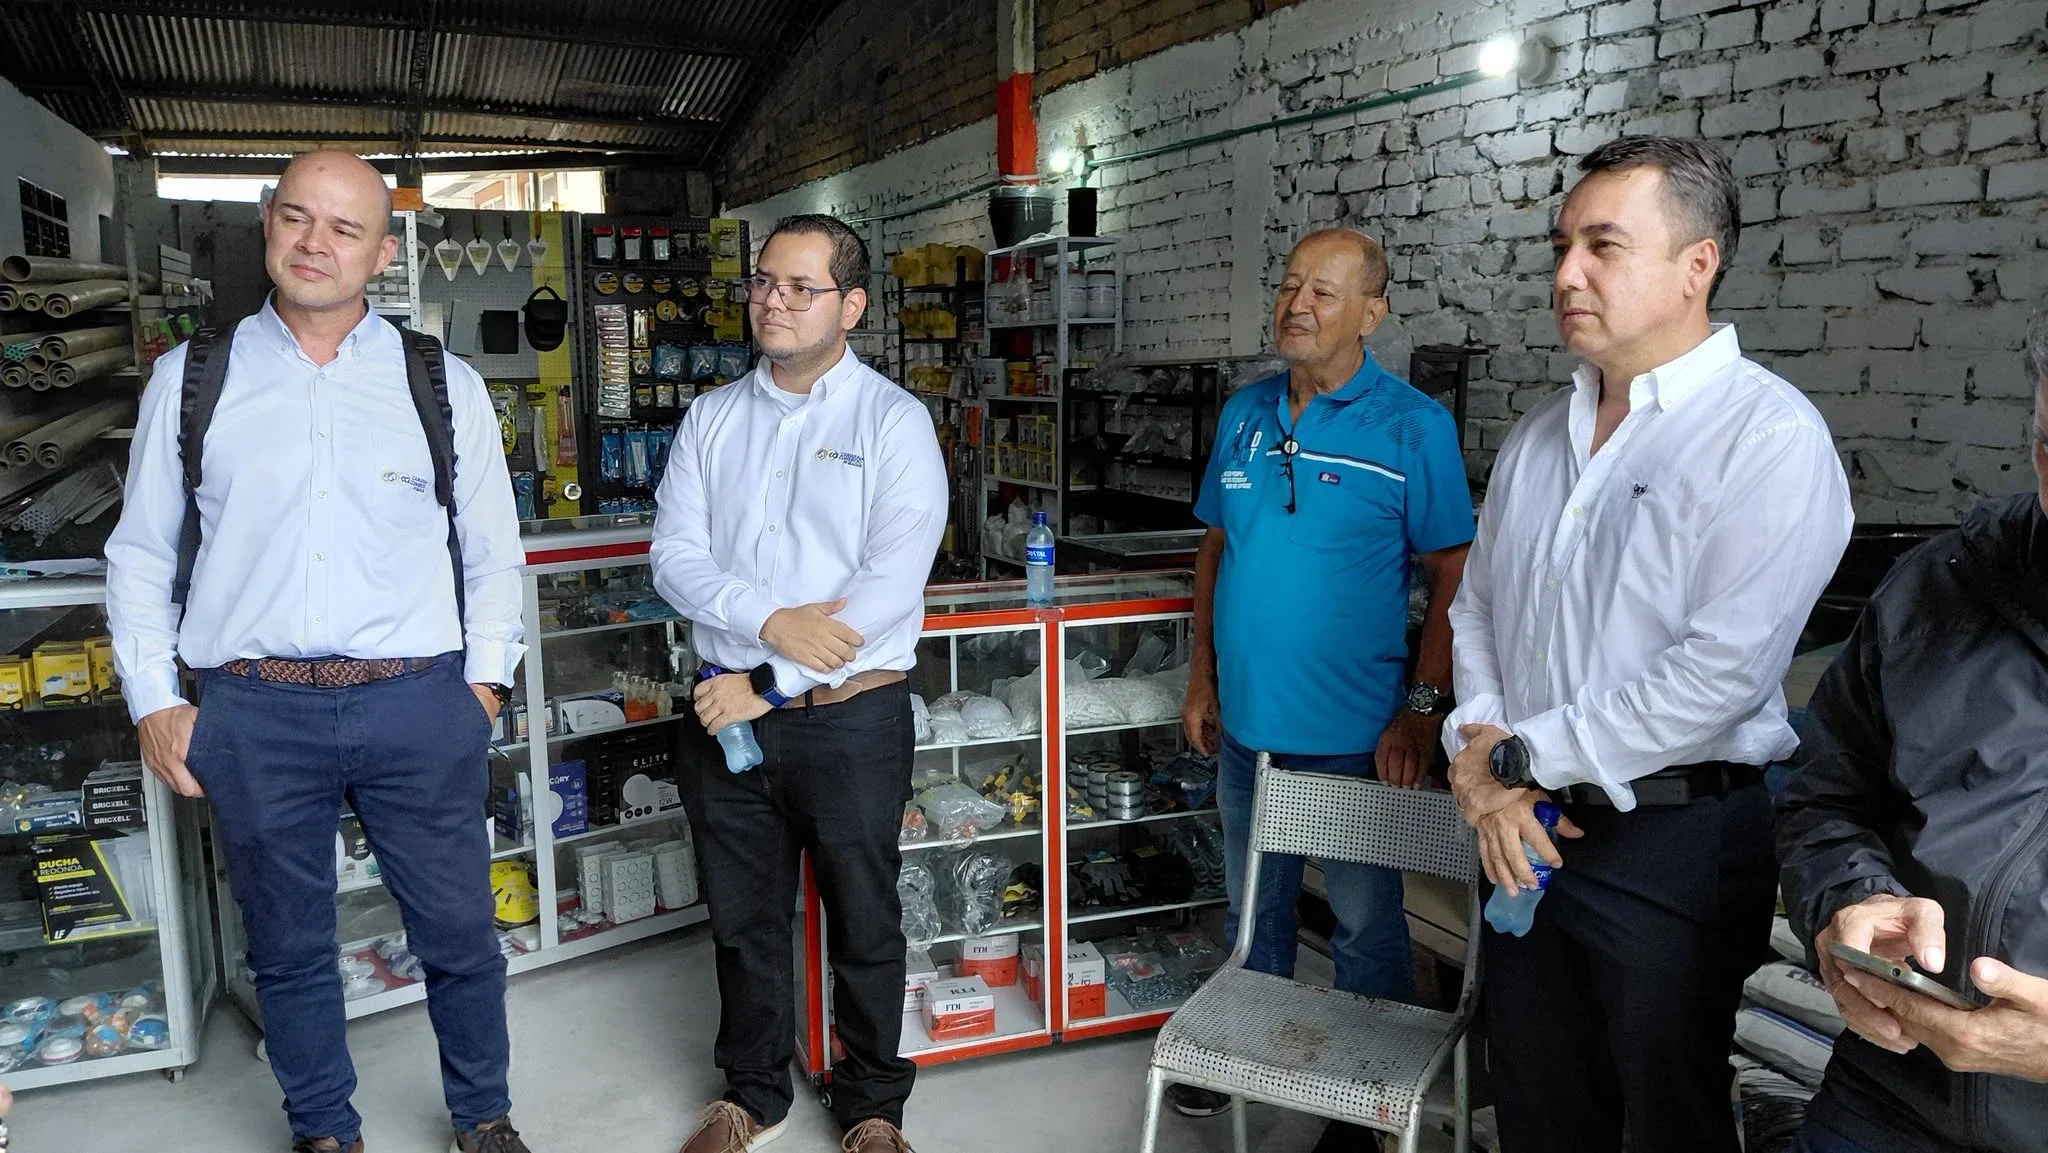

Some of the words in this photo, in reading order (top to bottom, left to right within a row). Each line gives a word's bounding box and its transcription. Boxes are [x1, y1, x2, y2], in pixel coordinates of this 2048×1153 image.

[1250, 431, 1262, 448] D
[1248, 447, 1258, 462] T
[632, 753, 669, 767] ELITE
[38, 857, 80, 870] DUCHA
[40, 865, 83, 876] REDONDA
